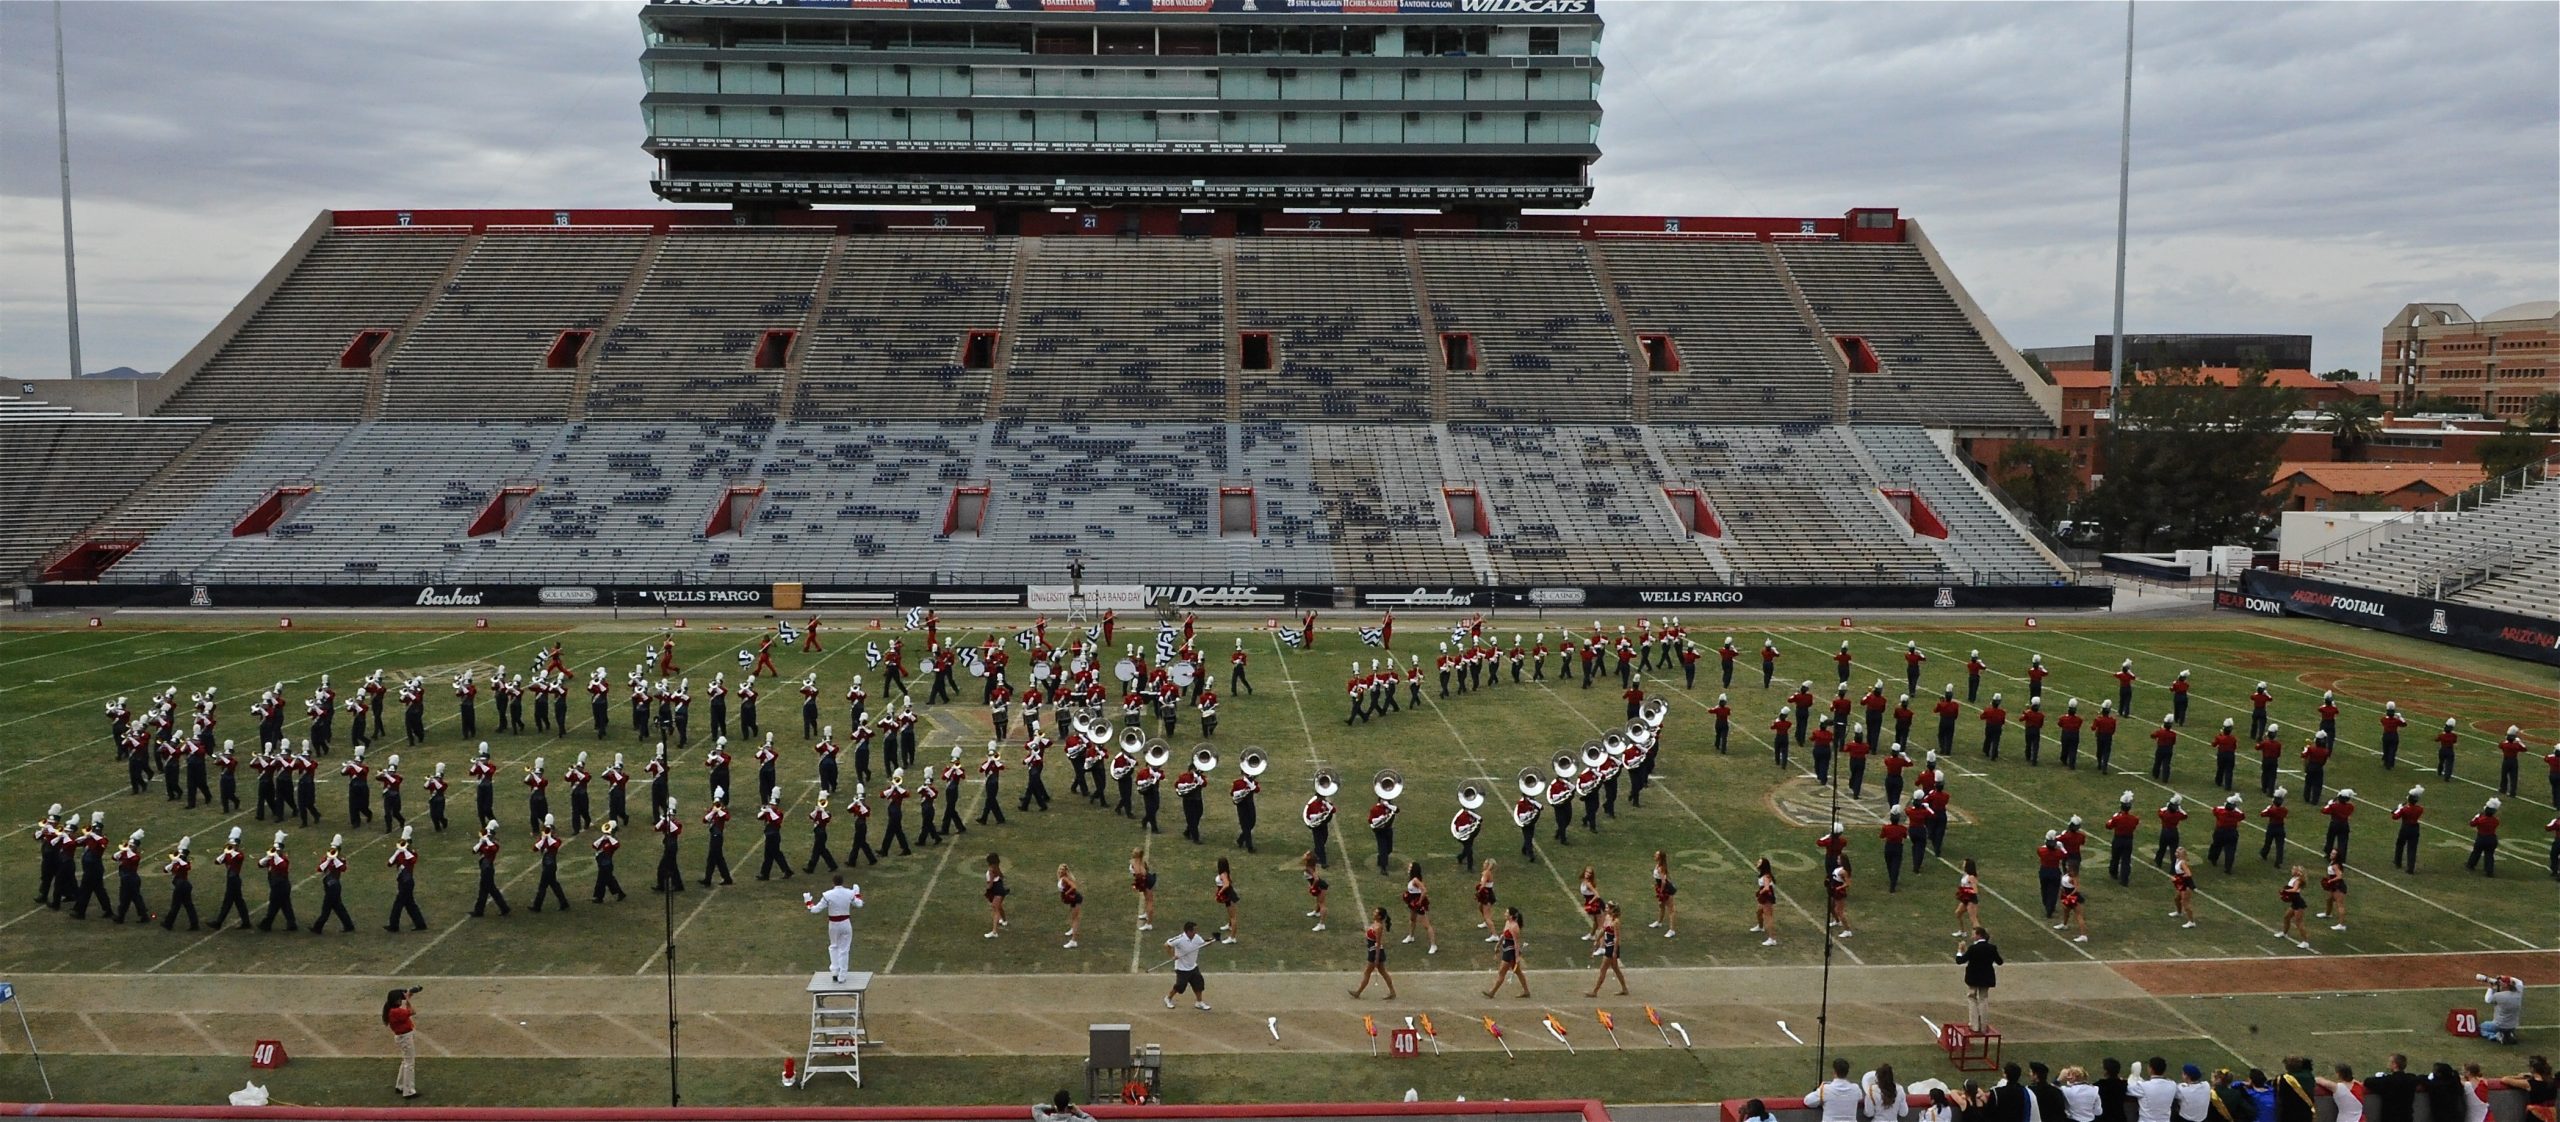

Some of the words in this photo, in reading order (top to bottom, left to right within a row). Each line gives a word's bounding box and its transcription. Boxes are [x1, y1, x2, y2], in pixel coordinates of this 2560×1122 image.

[1462, 0, 1587, 12] WILDCATS
[400, 217, 410, 226] 17
[556, 217, 567, 226] 18
[735, 217, 746, 225] 19
[934, 218, 947, 227] 20
[1085, 218, 1095, 227] 21
[1309, 220, 1321, 229] 22
[1666, 224, 1678, 232] 24
[1802, 225, 1814, 234] 25
[24, 384, 34, 393] 16
[416, 586, 483, 605] Bashas'
[653, 591, 705, 601] WELLS
[709, 591, 760, 601] FARGO
[1031, 592, 1065, 601] UNIVERSITY
[1108, 592, 1126, 601] BAND
[1128, 592, 1141, 601] DAY
[1640, 591, 1690, 602] WELLS
[1694, 591, 1743, 602] FARGO
[2456, 1013, 2476, 1033] 20
[1395, 1033, 1413, 1053] 40
[254, 1044, 274, 1064] 40
